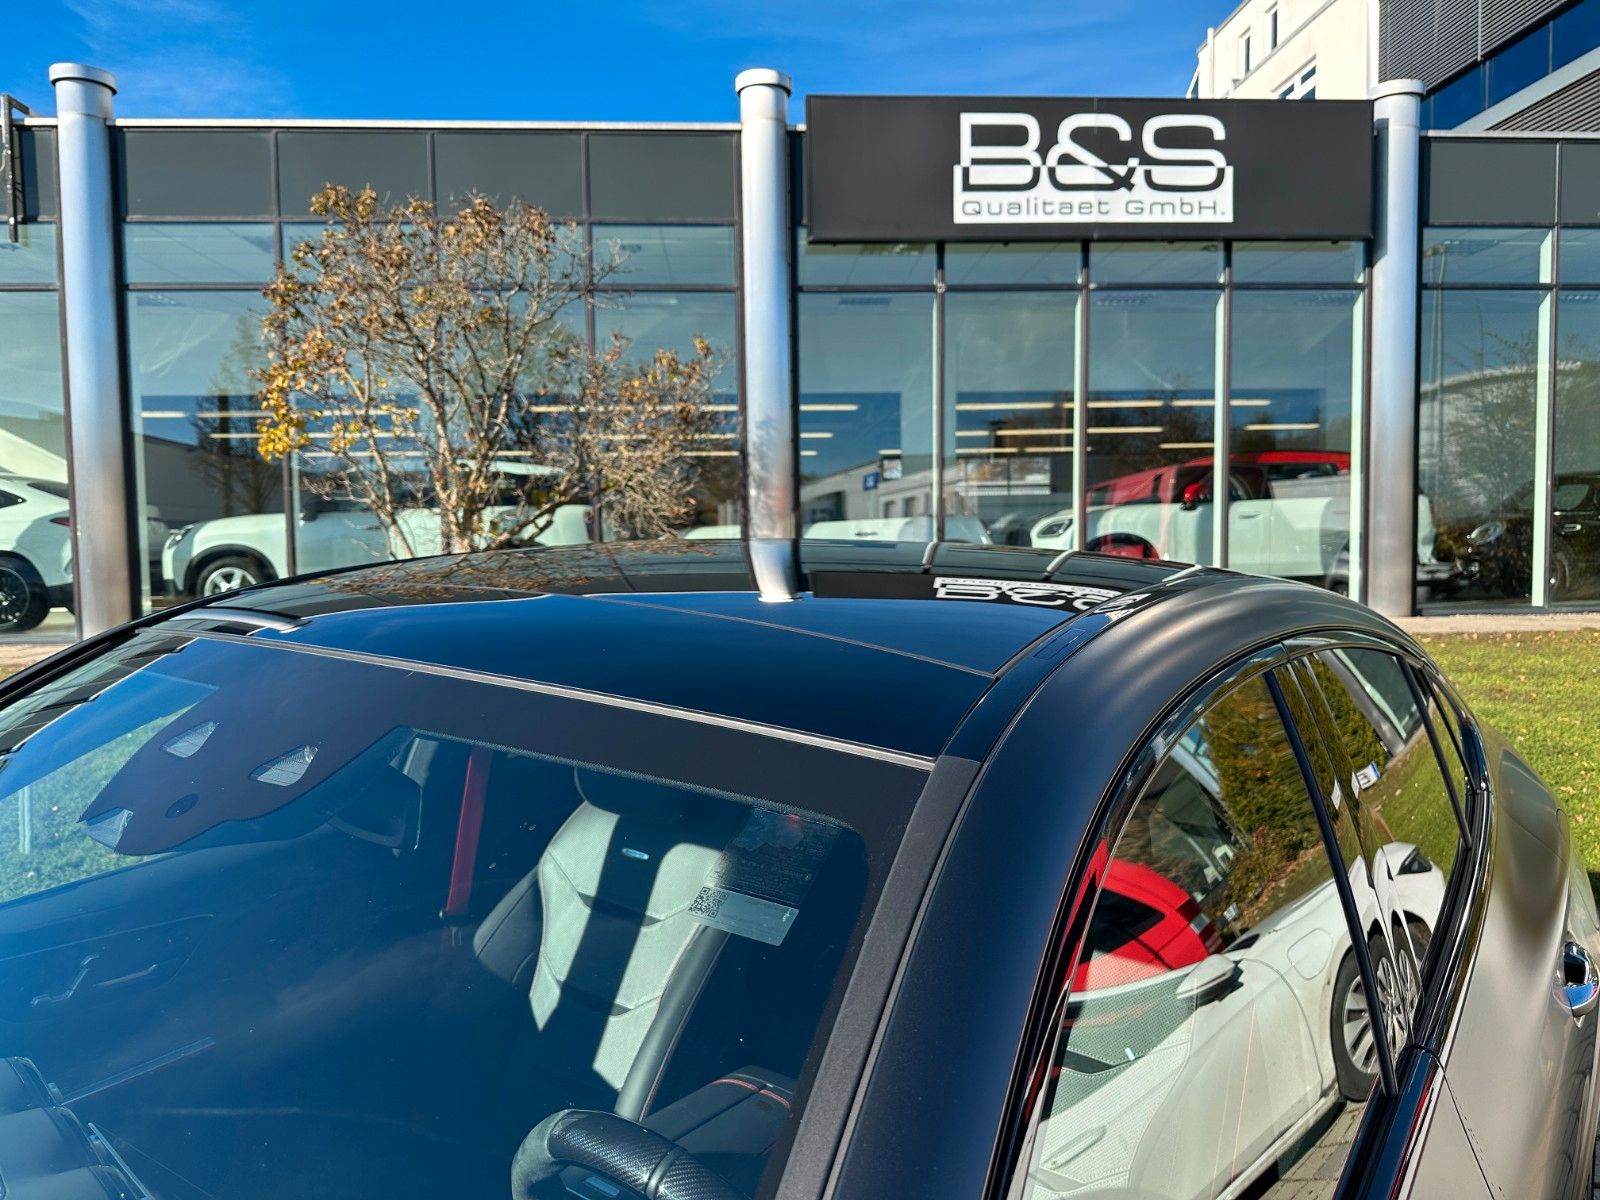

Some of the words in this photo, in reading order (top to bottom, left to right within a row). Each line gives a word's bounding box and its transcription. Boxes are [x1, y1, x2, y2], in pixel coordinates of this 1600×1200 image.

[959, 112, 1227, 193] B&S
[961, 197, 1110, 216] Qualitaet
[1124, 197, 1226, 216] GmbH.
